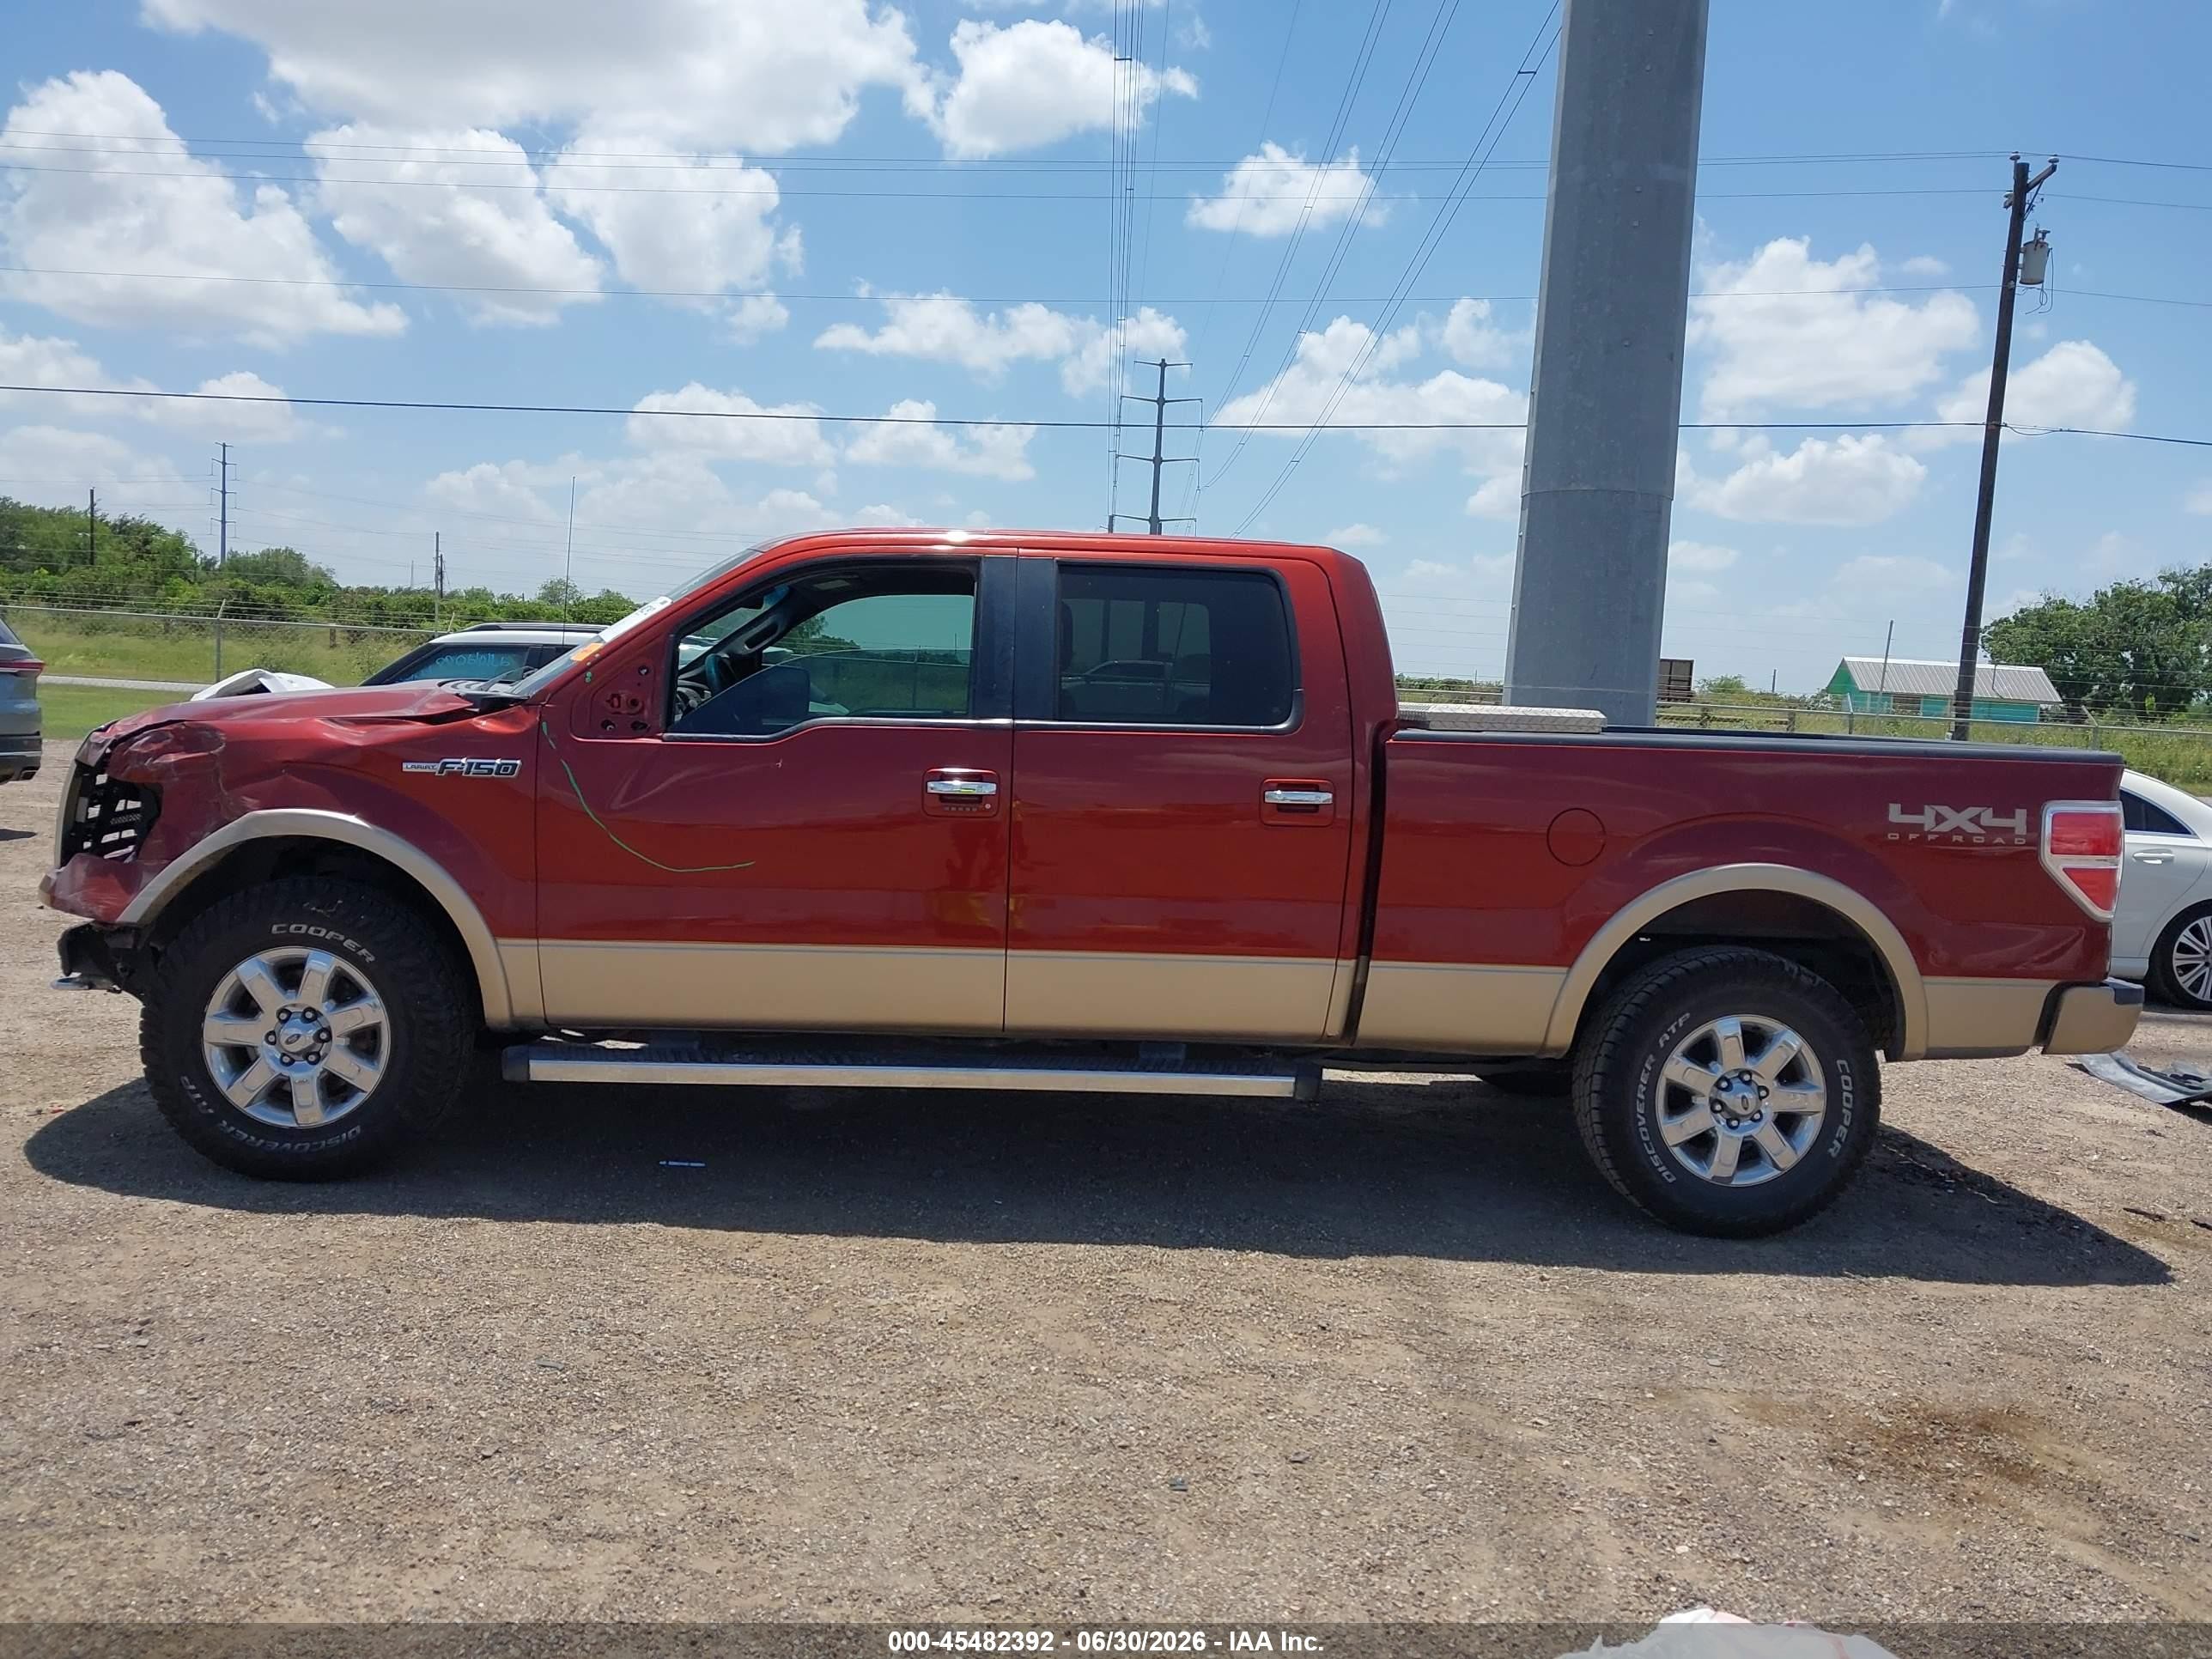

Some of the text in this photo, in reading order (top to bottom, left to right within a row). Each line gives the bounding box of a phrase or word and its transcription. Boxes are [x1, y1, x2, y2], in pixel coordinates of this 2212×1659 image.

[435, 758, 522, 777] F-150
[270, 923, 376, 963] COOPER
[1635, 1054, 1676, 1184] DISCOVERER
[1827, 1059, 1853, 1158] COOPER
